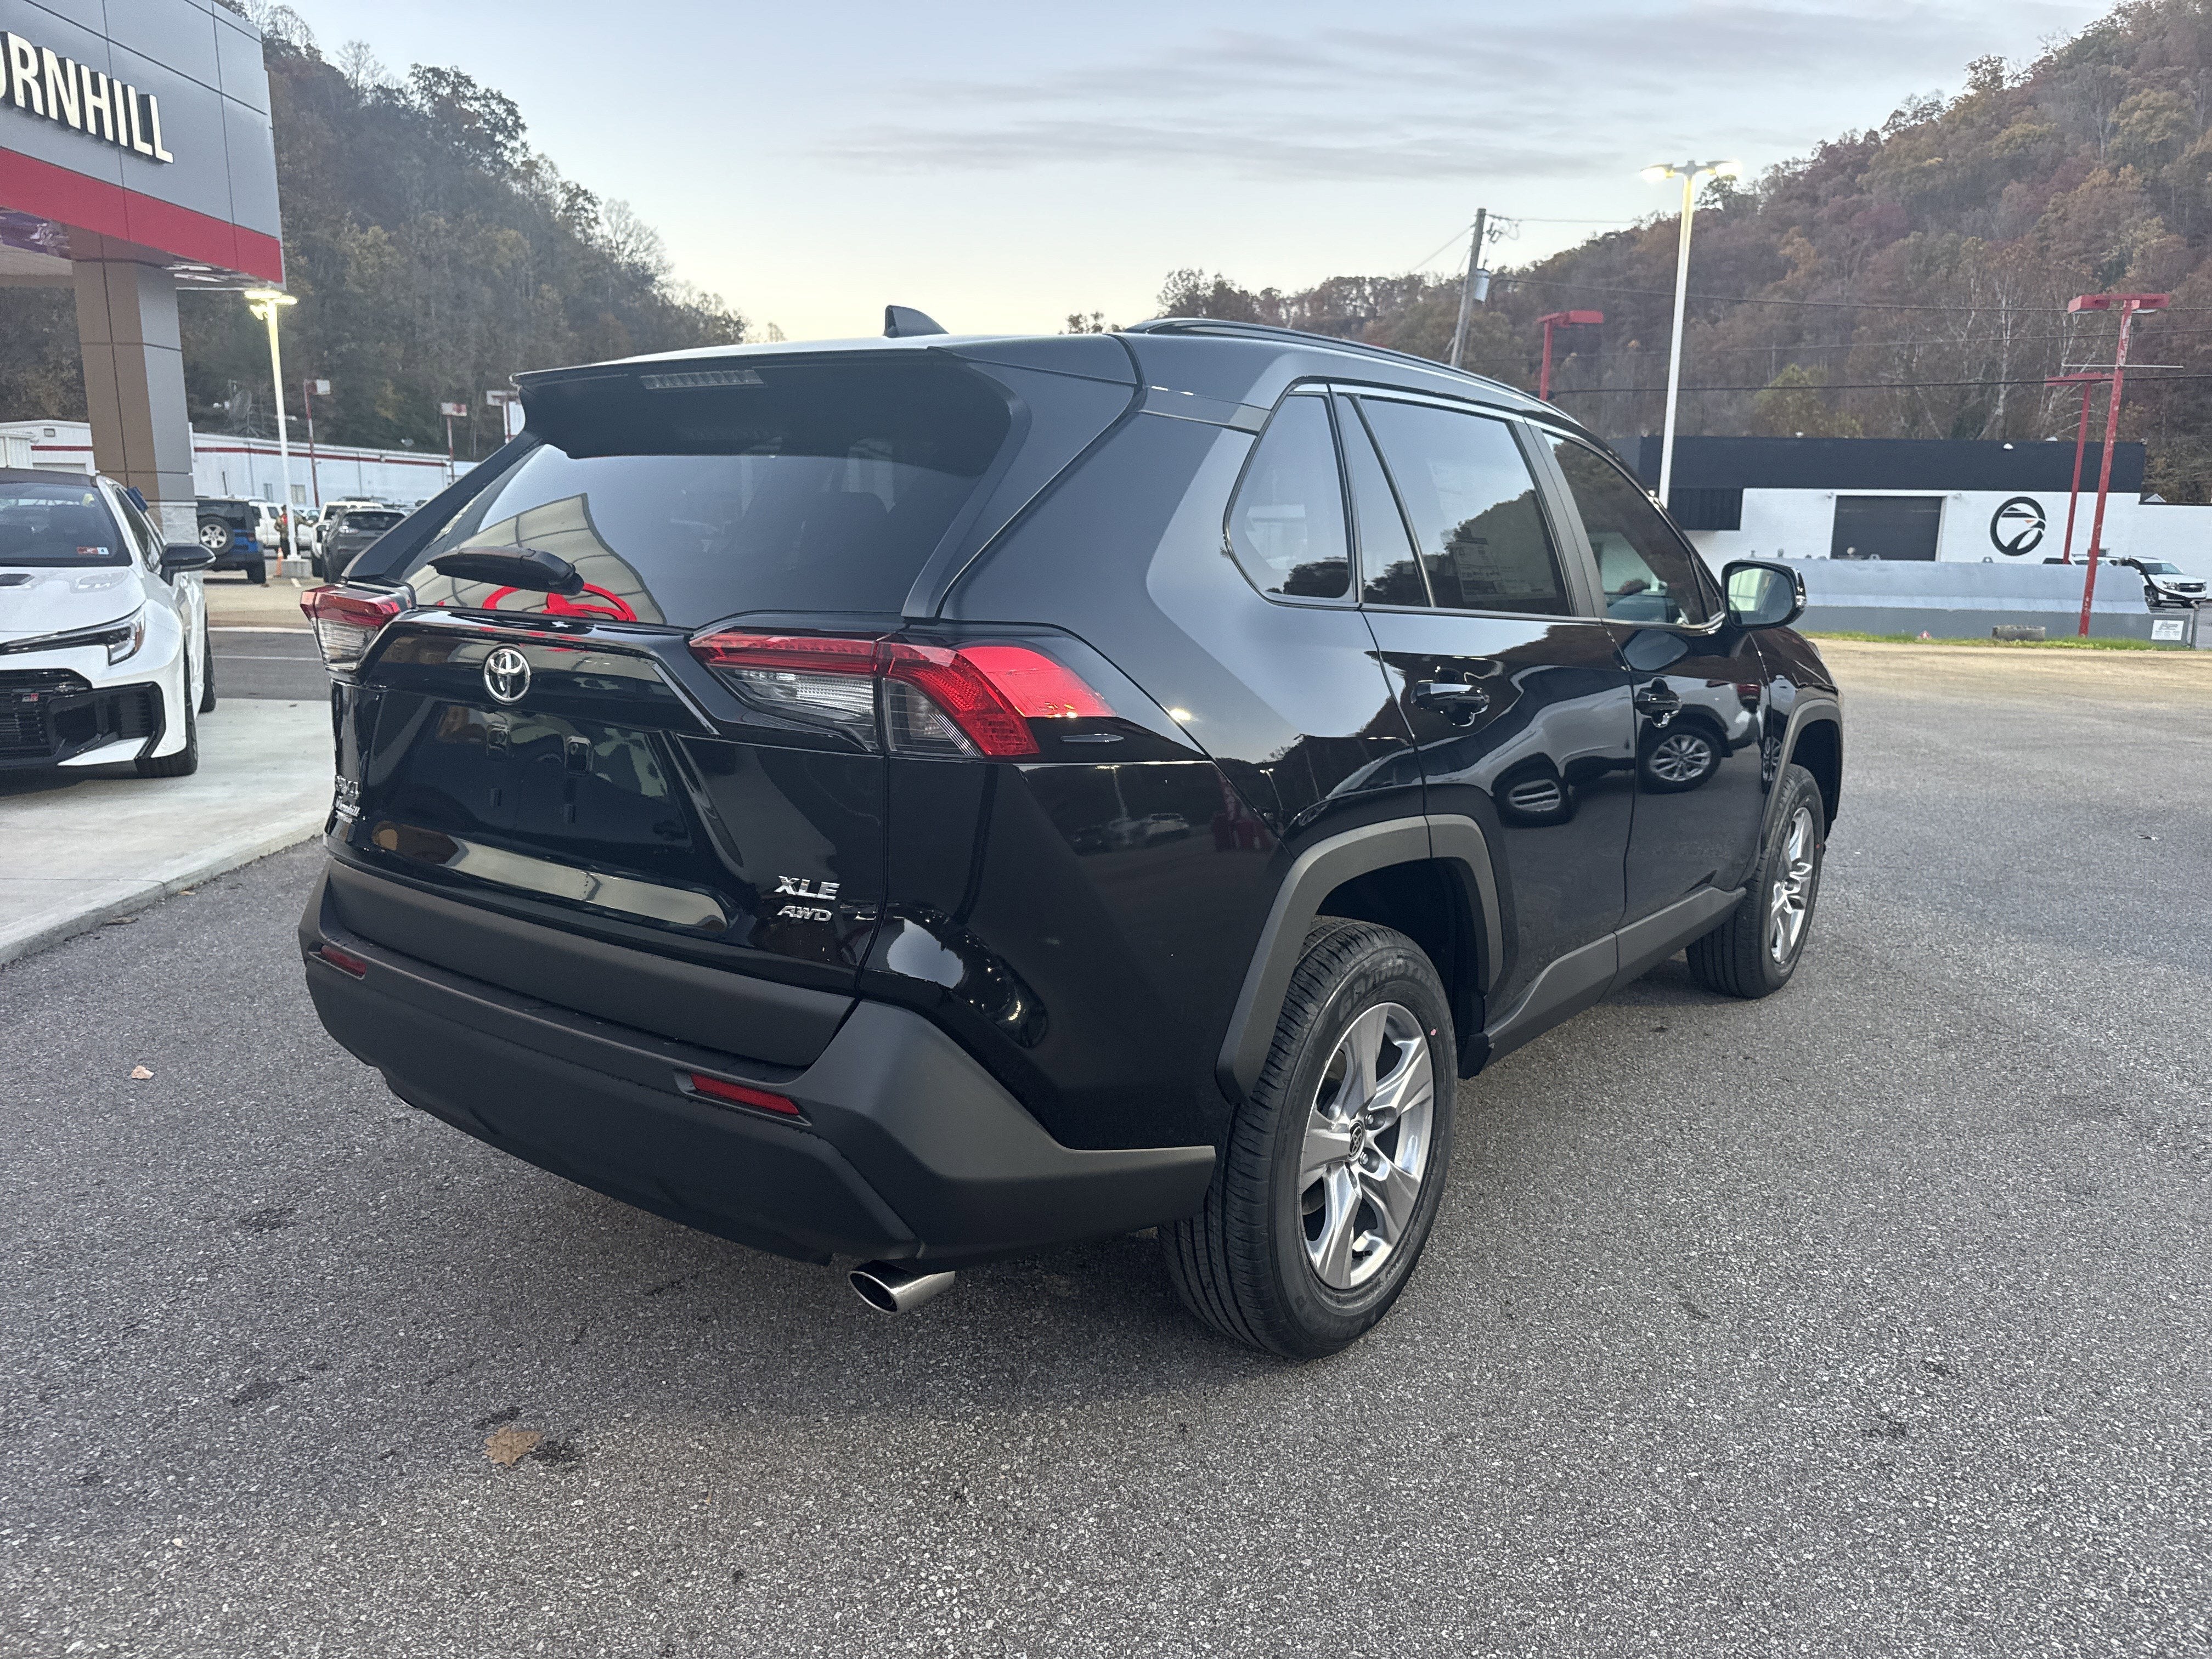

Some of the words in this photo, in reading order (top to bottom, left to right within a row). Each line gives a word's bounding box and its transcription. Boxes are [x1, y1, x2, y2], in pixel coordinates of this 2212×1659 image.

[0, 31, 174, 163] RNHILL
[774, 876, 840, 900] XLE
[777, 905, 832, 922] AWD
